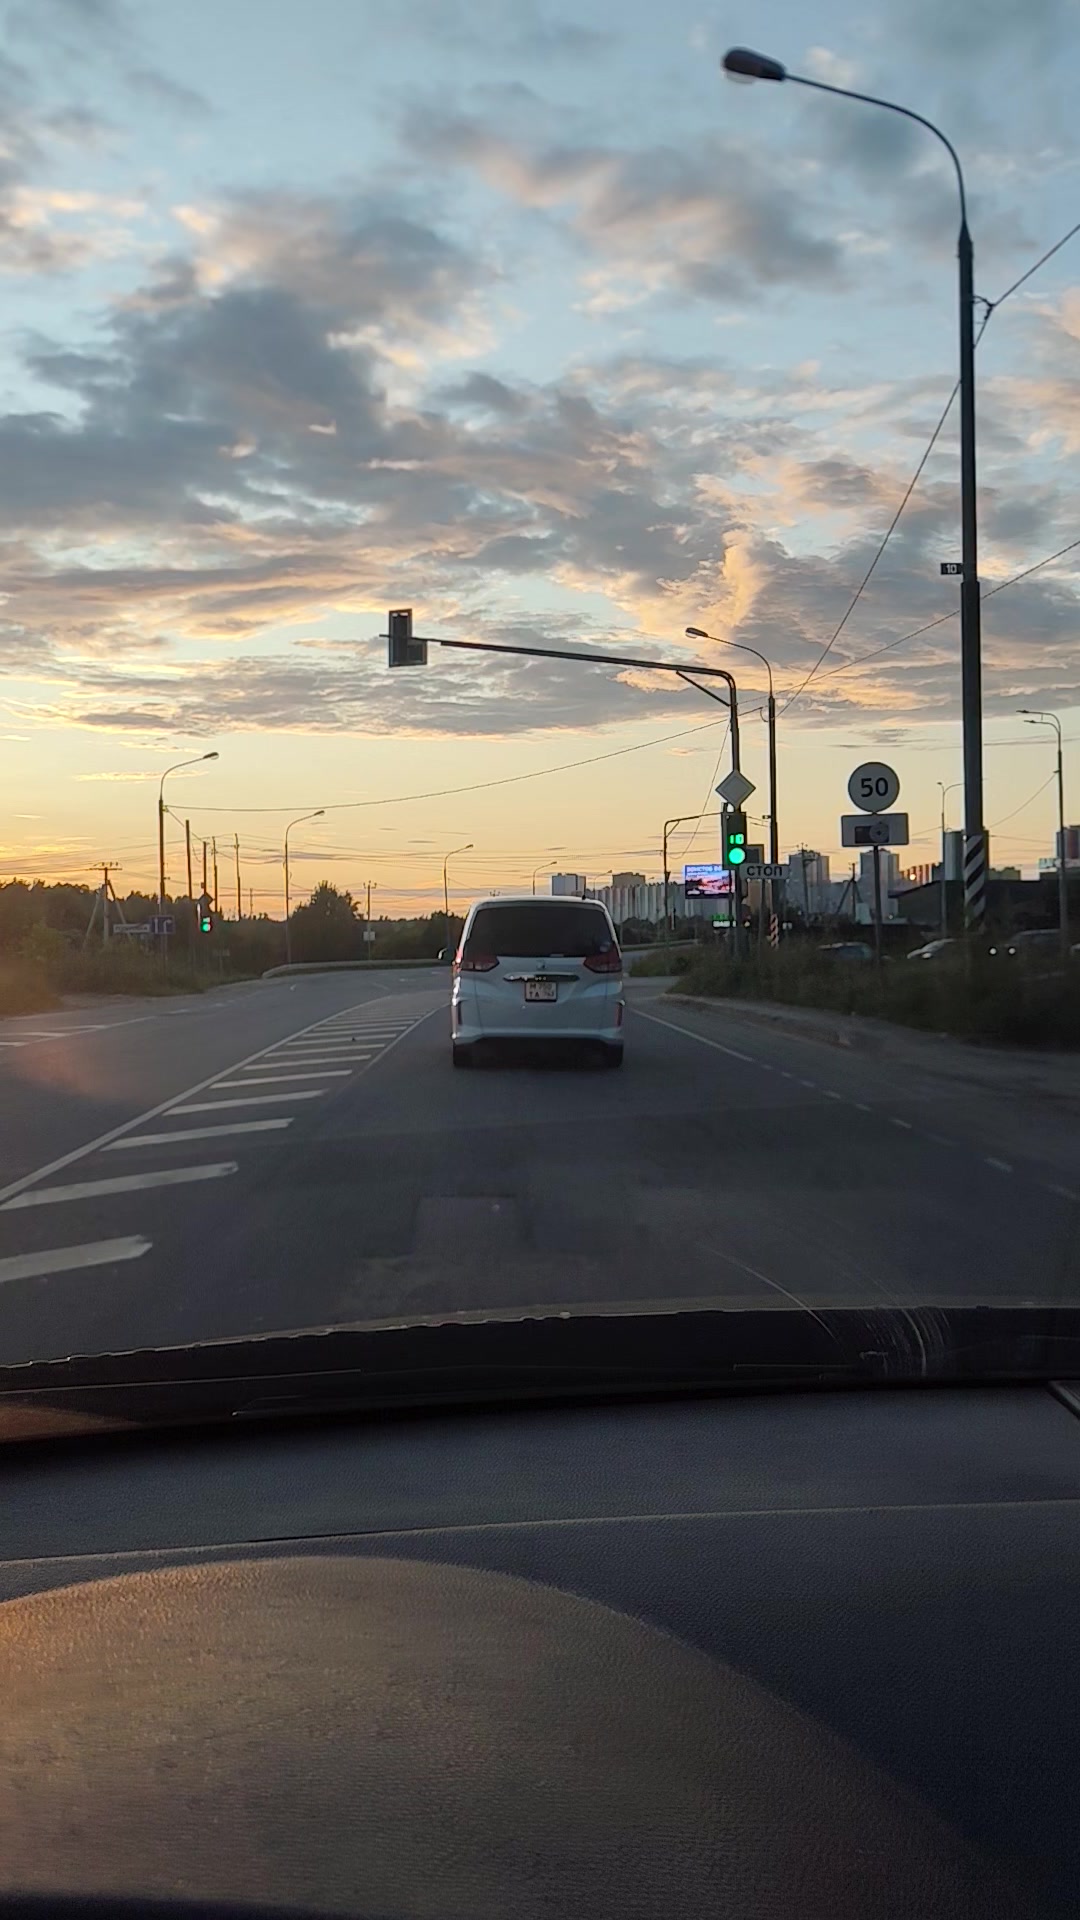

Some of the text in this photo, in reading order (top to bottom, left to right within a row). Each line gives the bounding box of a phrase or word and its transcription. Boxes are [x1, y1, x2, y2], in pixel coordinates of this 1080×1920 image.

[946, 563, 957, 574] 10
[860, 777, 889, 798] 50
[729, 833, 745, 845] 10
[746, 865, 783, 877] СТОП
